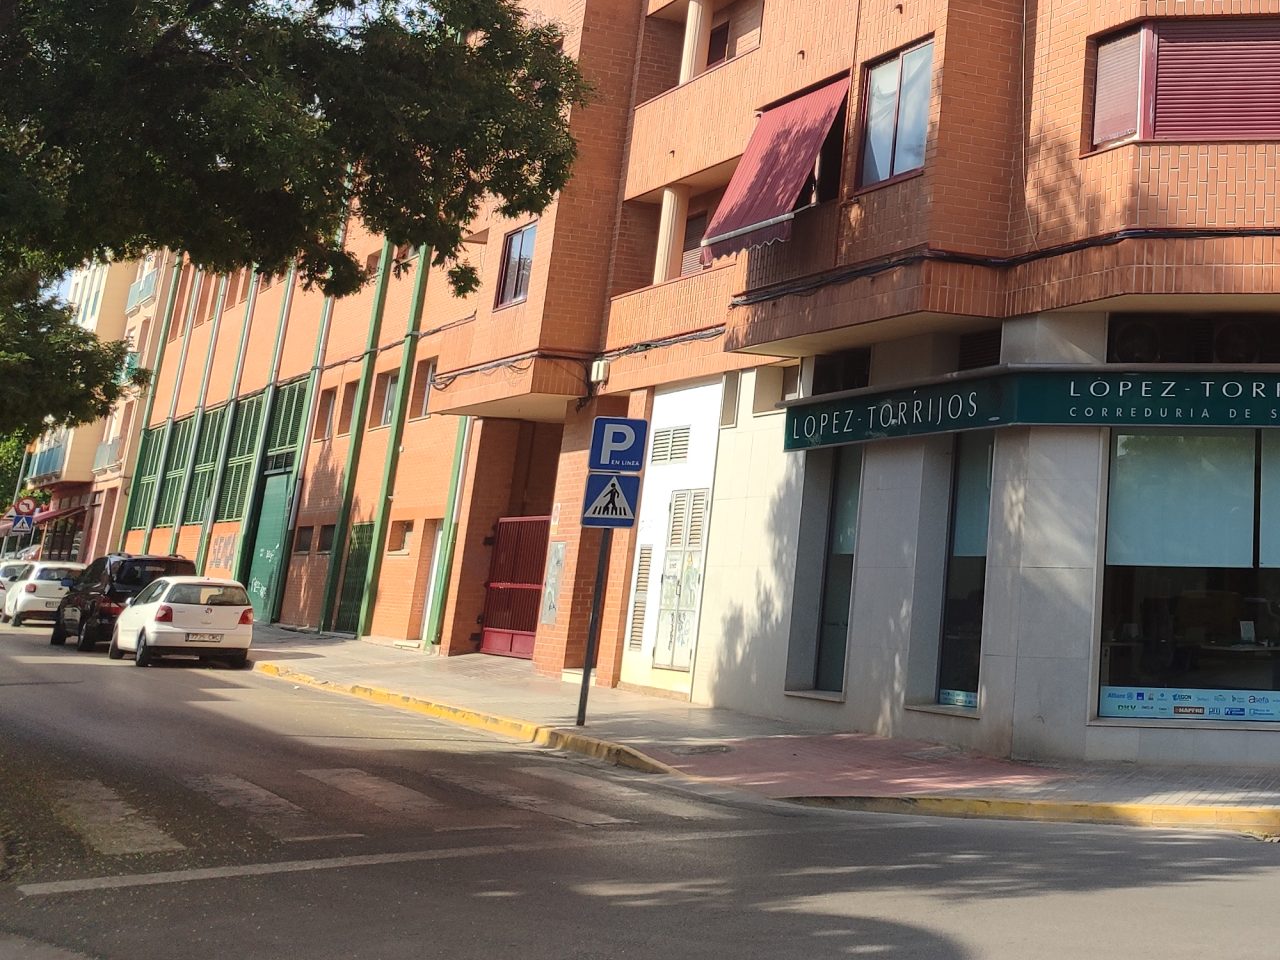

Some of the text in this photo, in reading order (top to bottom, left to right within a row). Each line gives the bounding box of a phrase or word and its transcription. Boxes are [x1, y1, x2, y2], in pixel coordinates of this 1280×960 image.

[1069, 407, 1210, 419] CORREDURIA
[1229, 408, 1251, 419] DE
[600, 423, 636, 465] P
